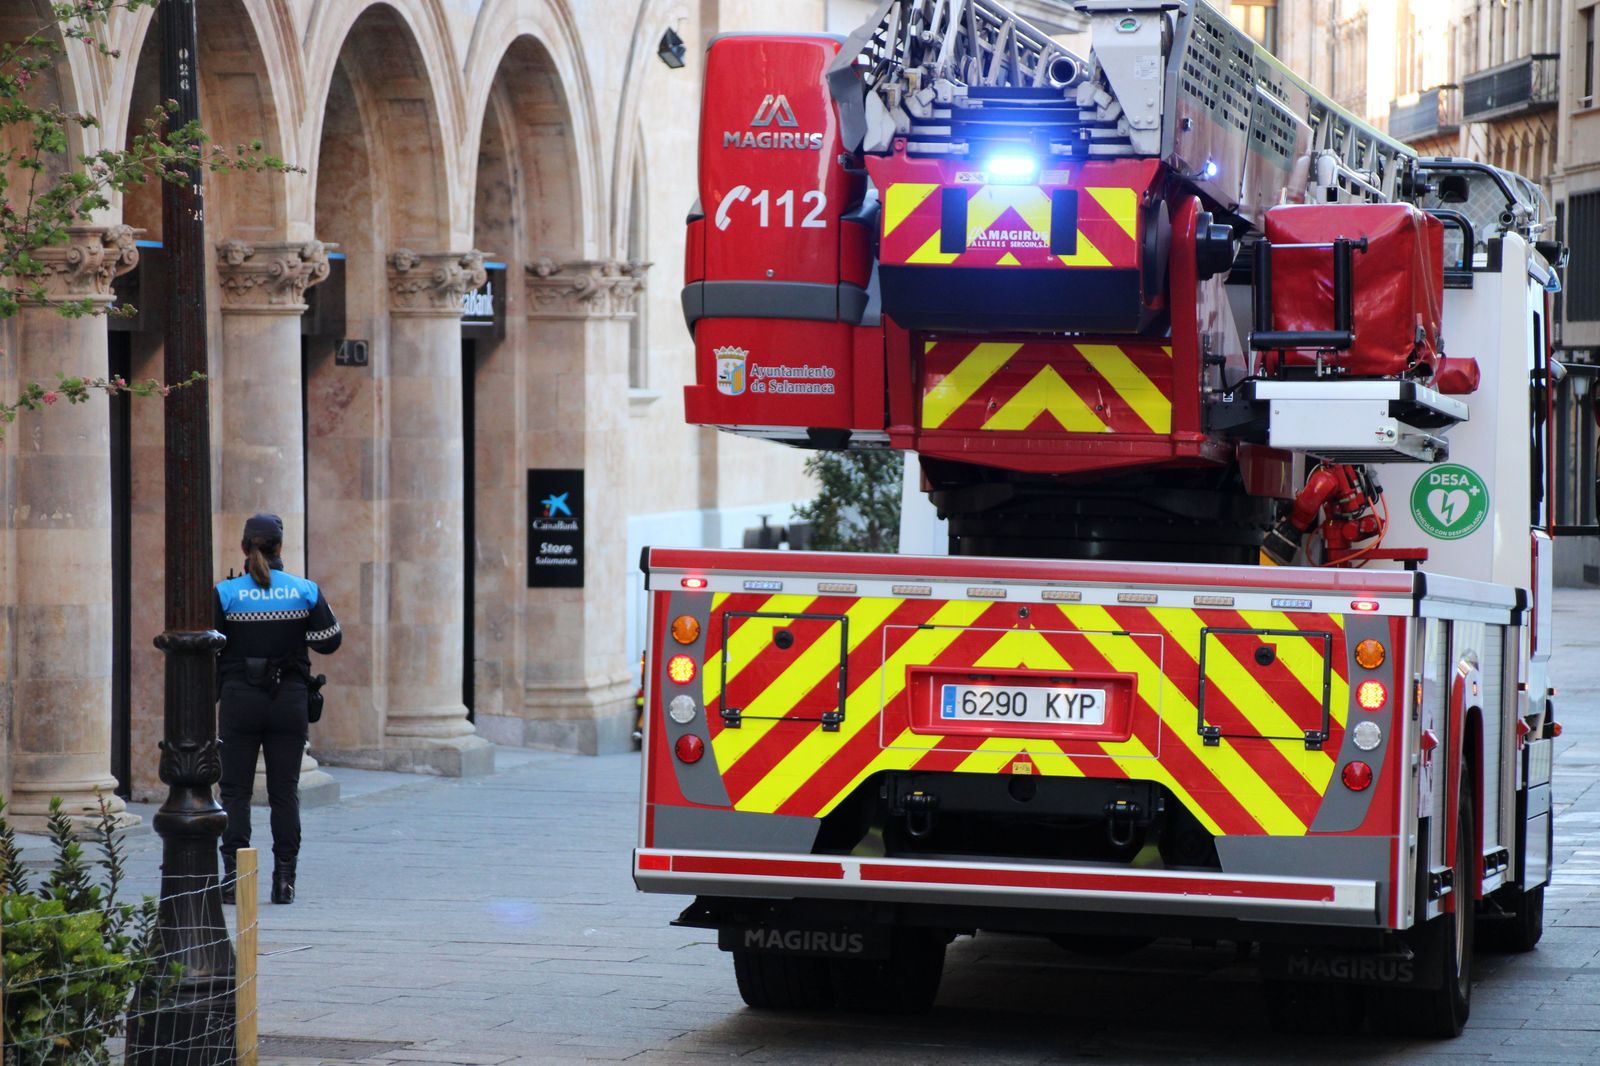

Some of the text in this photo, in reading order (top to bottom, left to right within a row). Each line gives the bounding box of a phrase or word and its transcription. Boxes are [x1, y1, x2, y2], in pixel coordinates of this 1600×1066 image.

[723, 131, 824, 150] MAGIRUS
[752, 189, 828, 228] 112
[988, 230, 1049, 241] MAGIRUS
[337, 340, 367, 364] 40
[750, 363, 836, 380] Ayuntamiento
[750, 379, 836, 395] de Salamanca
[1429, 473, 1470, 486] DESA
[1435, 528, 1448, 536] CON
[540, 542, 574, 555] Store
[535, 555, 578, 565] Salamanca
[238, 584, 301, 601] POLICÍA
[945, 705, 953, 713] E
[962, 690, 1096, 719] 6290 KYP
[744, 929, 864, 954] MAGIRUS
[1287, 954, 1414, 982] MAGIRUS
